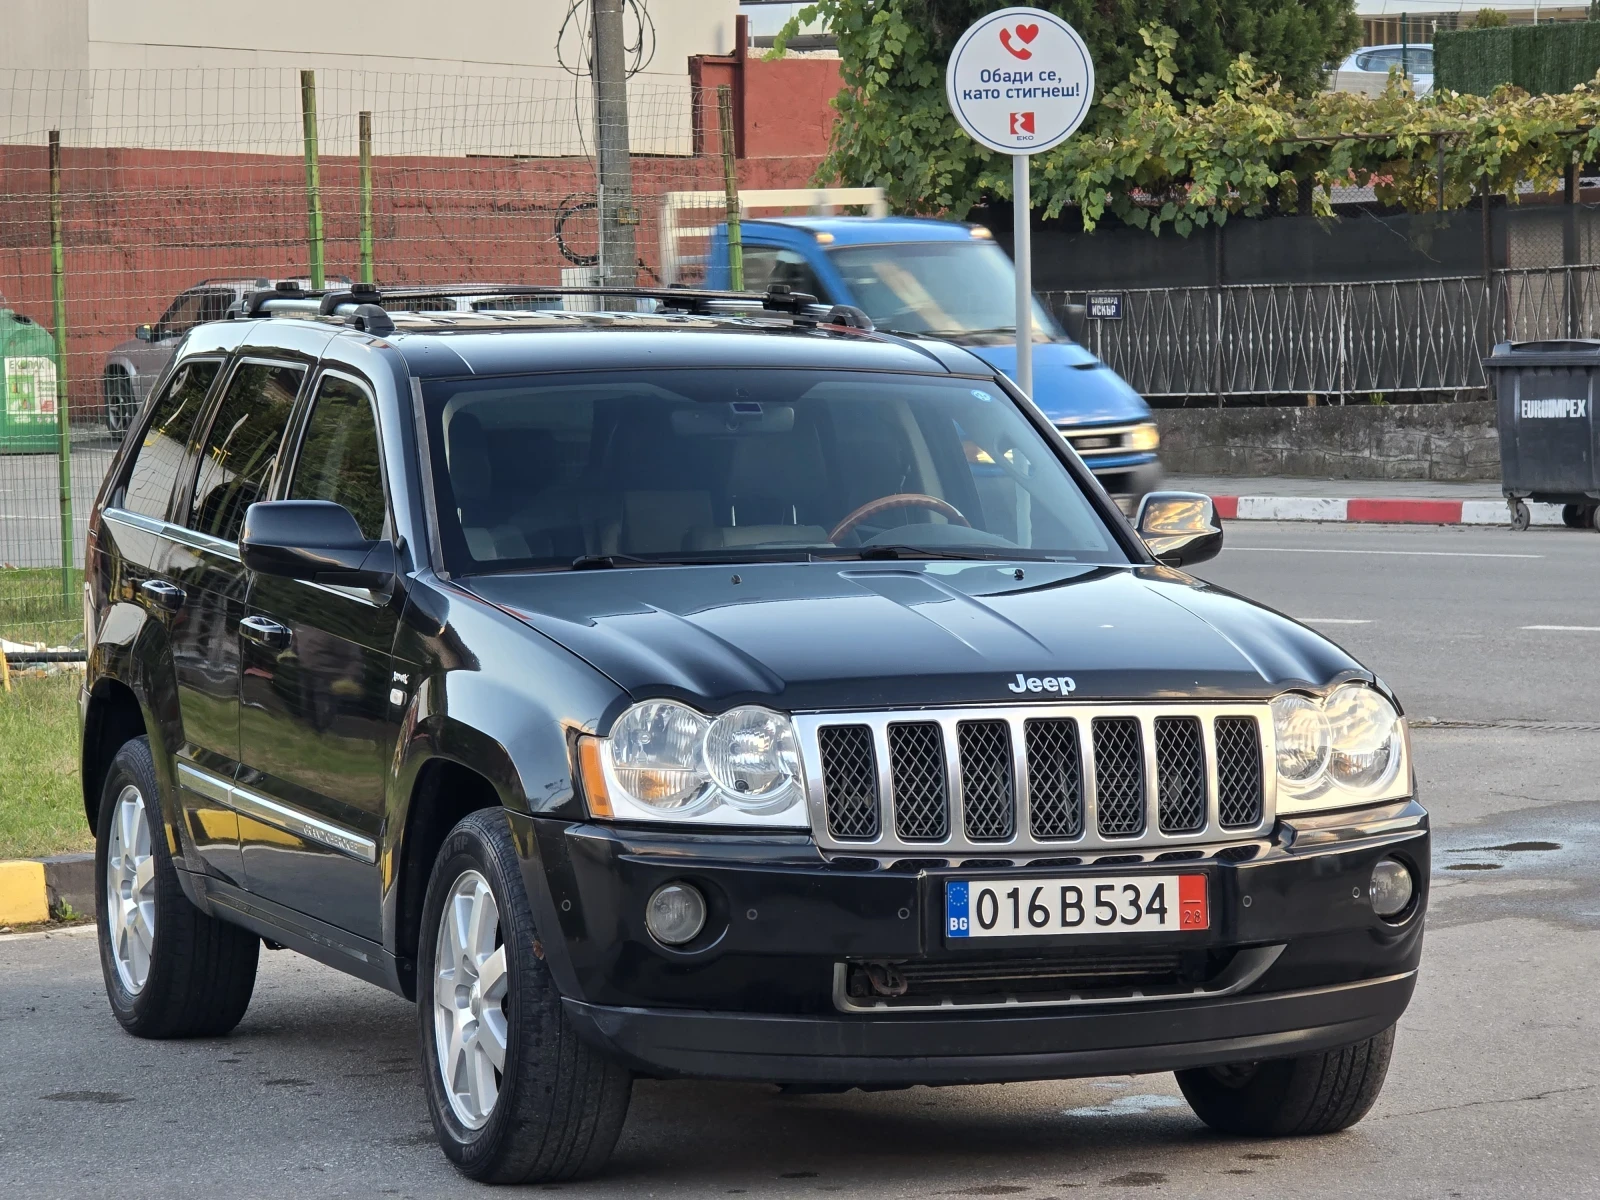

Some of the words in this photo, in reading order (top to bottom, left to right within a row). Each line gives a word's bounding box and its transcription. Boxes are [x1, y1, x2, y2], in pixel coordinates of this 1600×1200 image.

[980, 68, 1033, 85] Обади
[1039, 70, 1062, 83] се,
[963, 88, 1001, 100] като
[1006, 83, 1080, 99] стигнеш!
[1091, 305, 1116, 316] ИСКЪР
[1521, 399, 1587, 419] EUROIMPEX
[1008, 673, 1076, 696] Jeep
[949, 917, 968, 931] BG
[1183, 910, 1202, 925] 28
